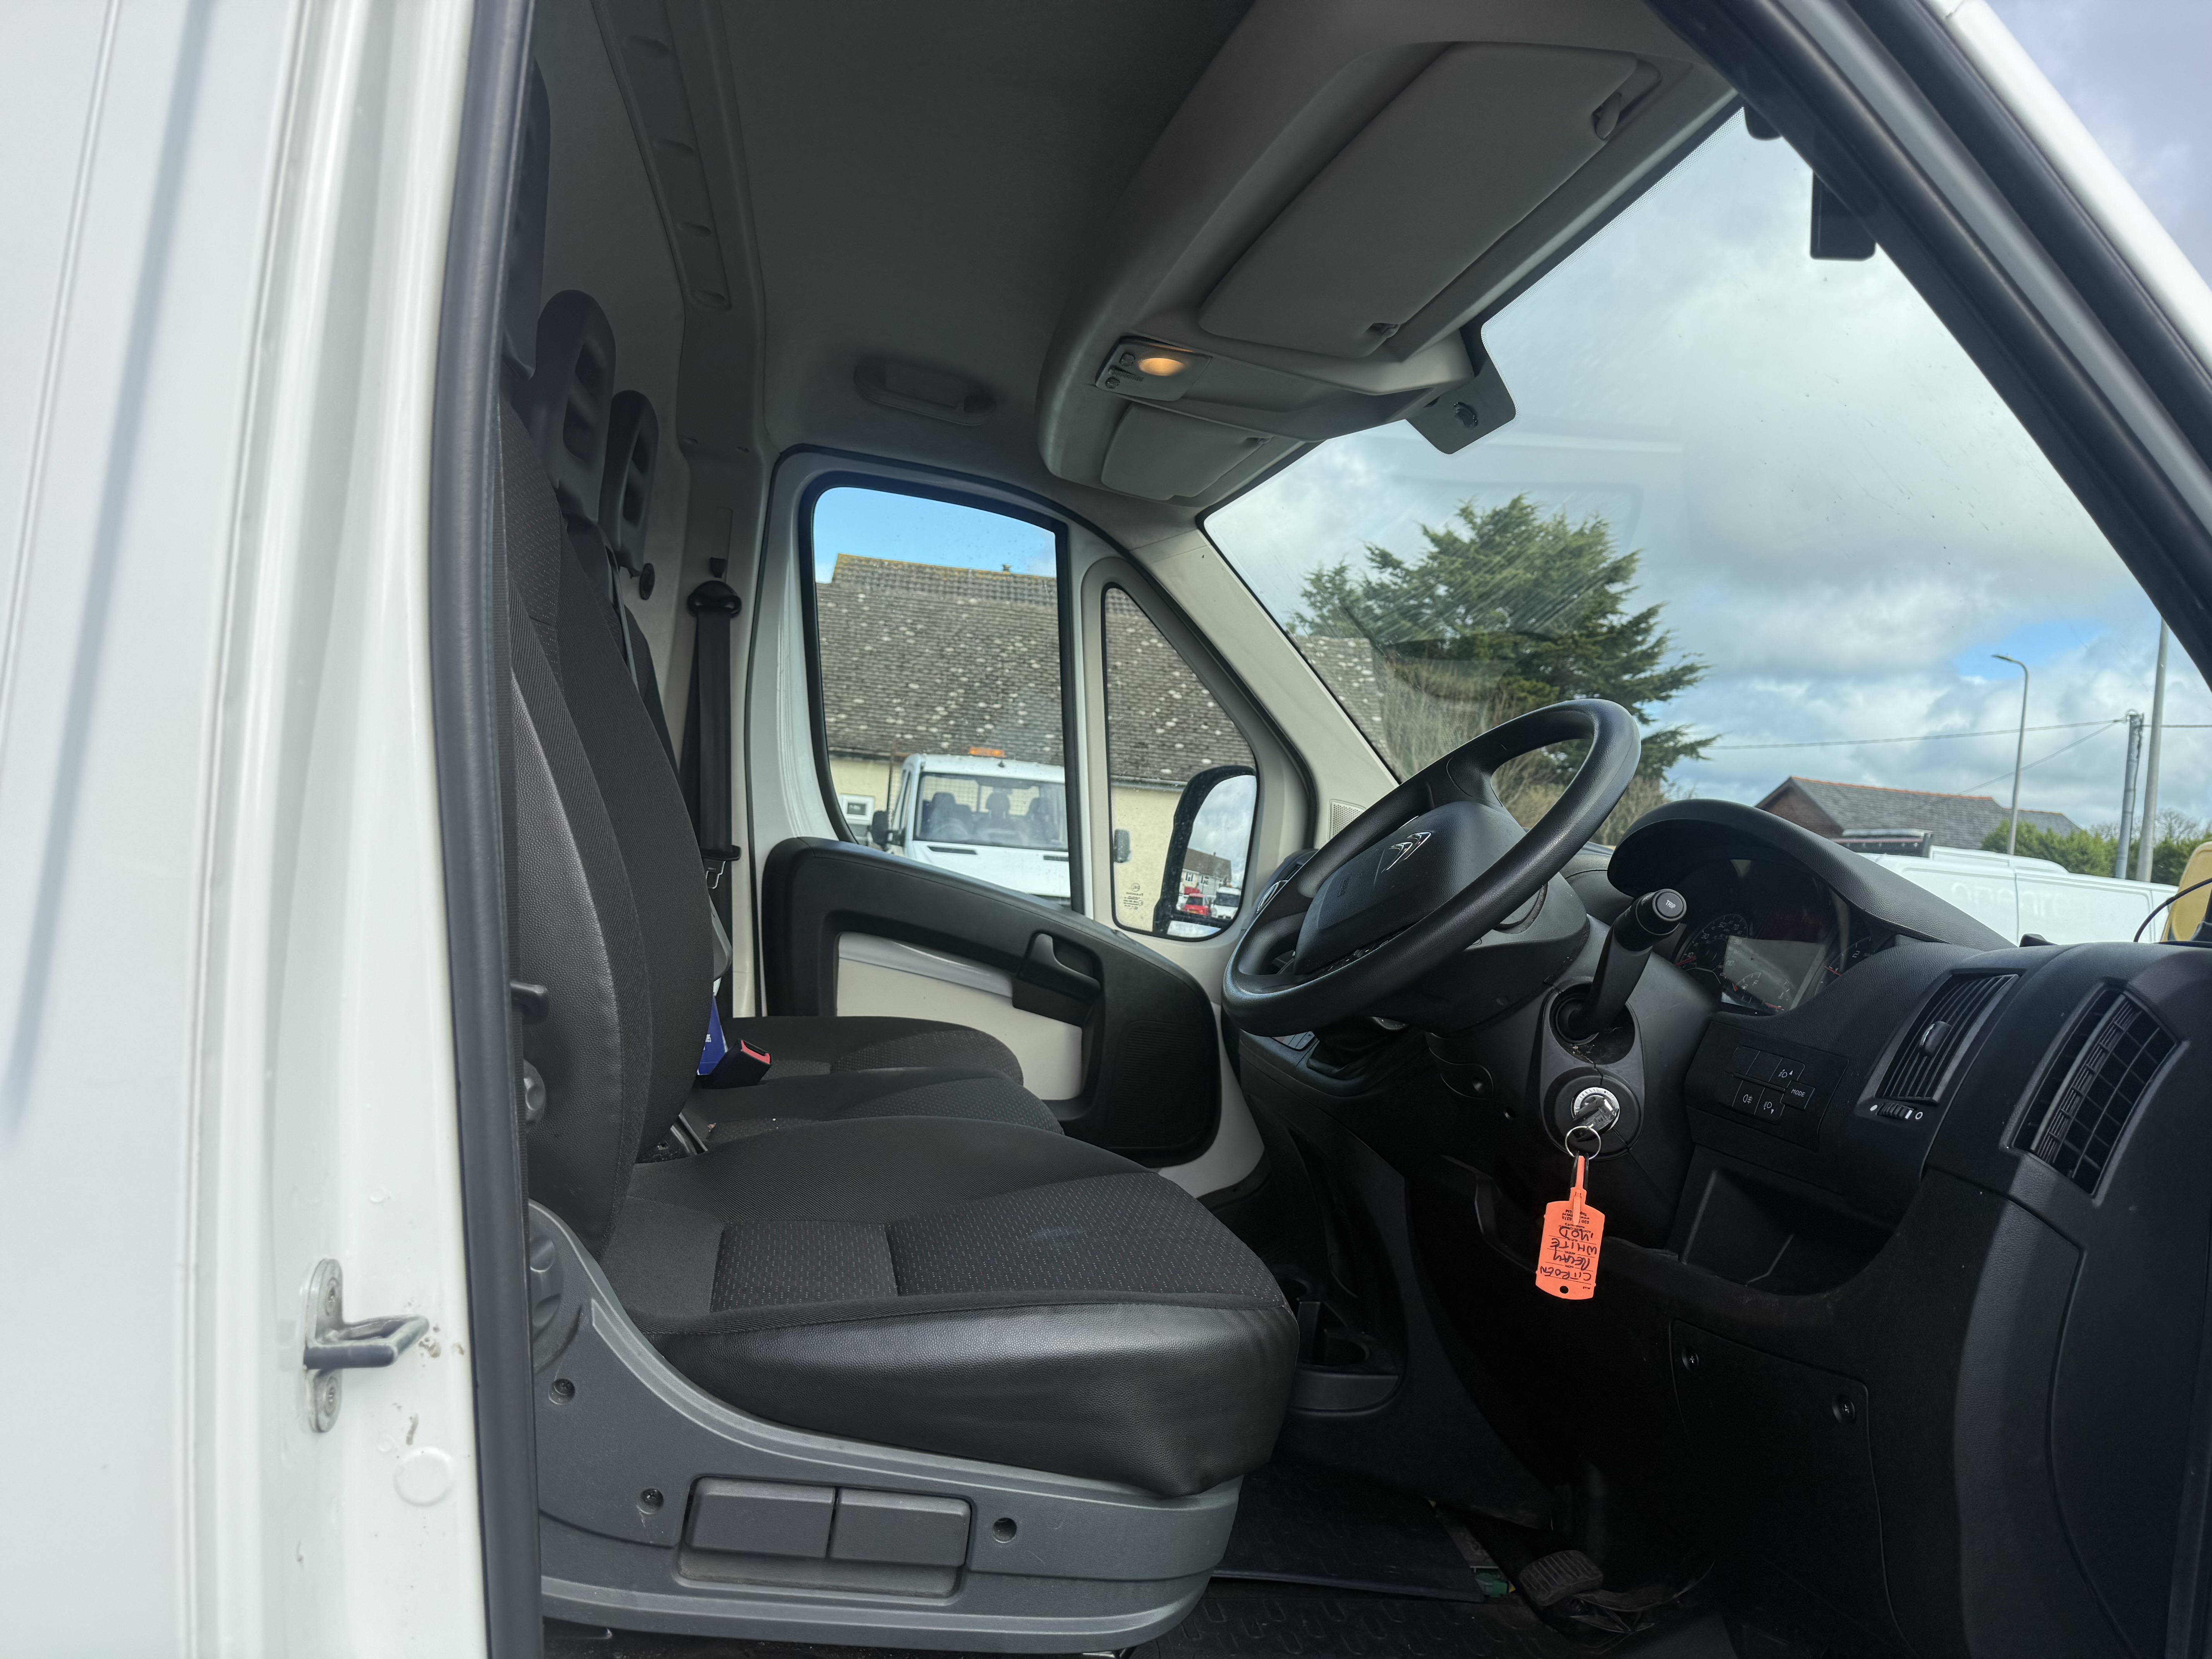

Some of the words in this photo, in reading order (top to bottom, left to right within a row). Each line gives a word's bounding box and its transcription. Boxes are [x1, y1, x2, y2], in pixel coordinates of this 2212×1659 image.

[1666, 900, 1676, 908] TRIP
[1791, 1089, 1806, 1097] MODE
[1550, 1238, 1597, 1255] WHITE
[1540, 1266, 1592, 1281] CITROEN
